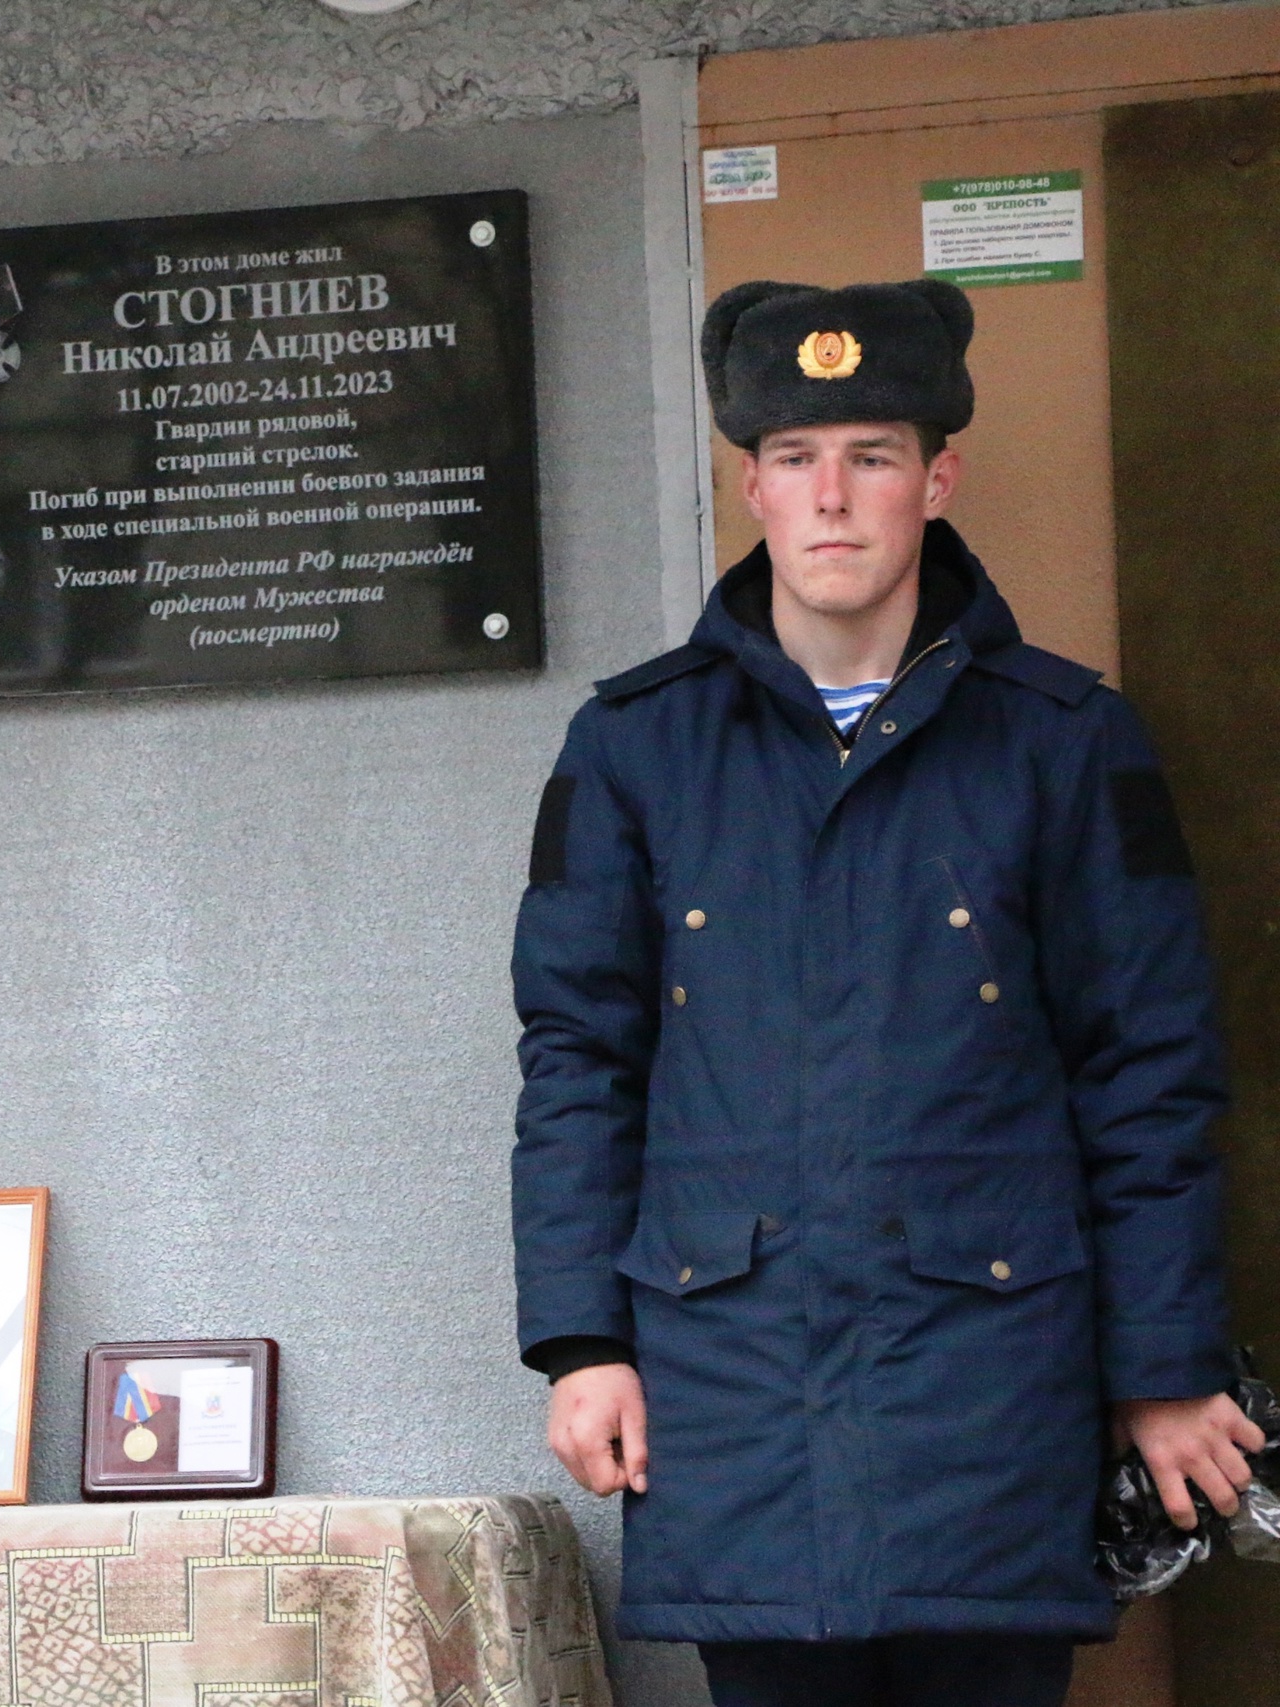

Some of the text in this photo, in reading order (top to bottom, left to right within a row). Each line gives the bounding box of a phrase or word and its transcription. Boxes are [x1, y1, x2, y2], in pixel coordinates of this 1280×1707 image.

[953, 203, 977, 213] ООО
[930, 220, 1073, 236] ПРАВИЛА ПОЛЬЗОВАНИЯ ДОМОФОНОМ
[156, 246, 343, 275] В этом доме жил
[113, 274, 390, 330] СТОГНИЕВ
[62, 322, 458, 375] Николай Андреевич
[117, 369, 394, 413] 11.07.2002-24.11.2023
[155, 409, 358, 442] Гвардии рядовой,
[156, 442, 359, 472] старший стрелок.
[29, 463, 486, 512] Погиб при выполнении боевого задания
[41, 495, 483, 540] в ходе специальной военной операции.
[53, 543, 474, 590] Указом Президента РФ награждён
[149, 585, 384, 620] орденом Мужества
[189, 617, 341, 650] (посмертно)
